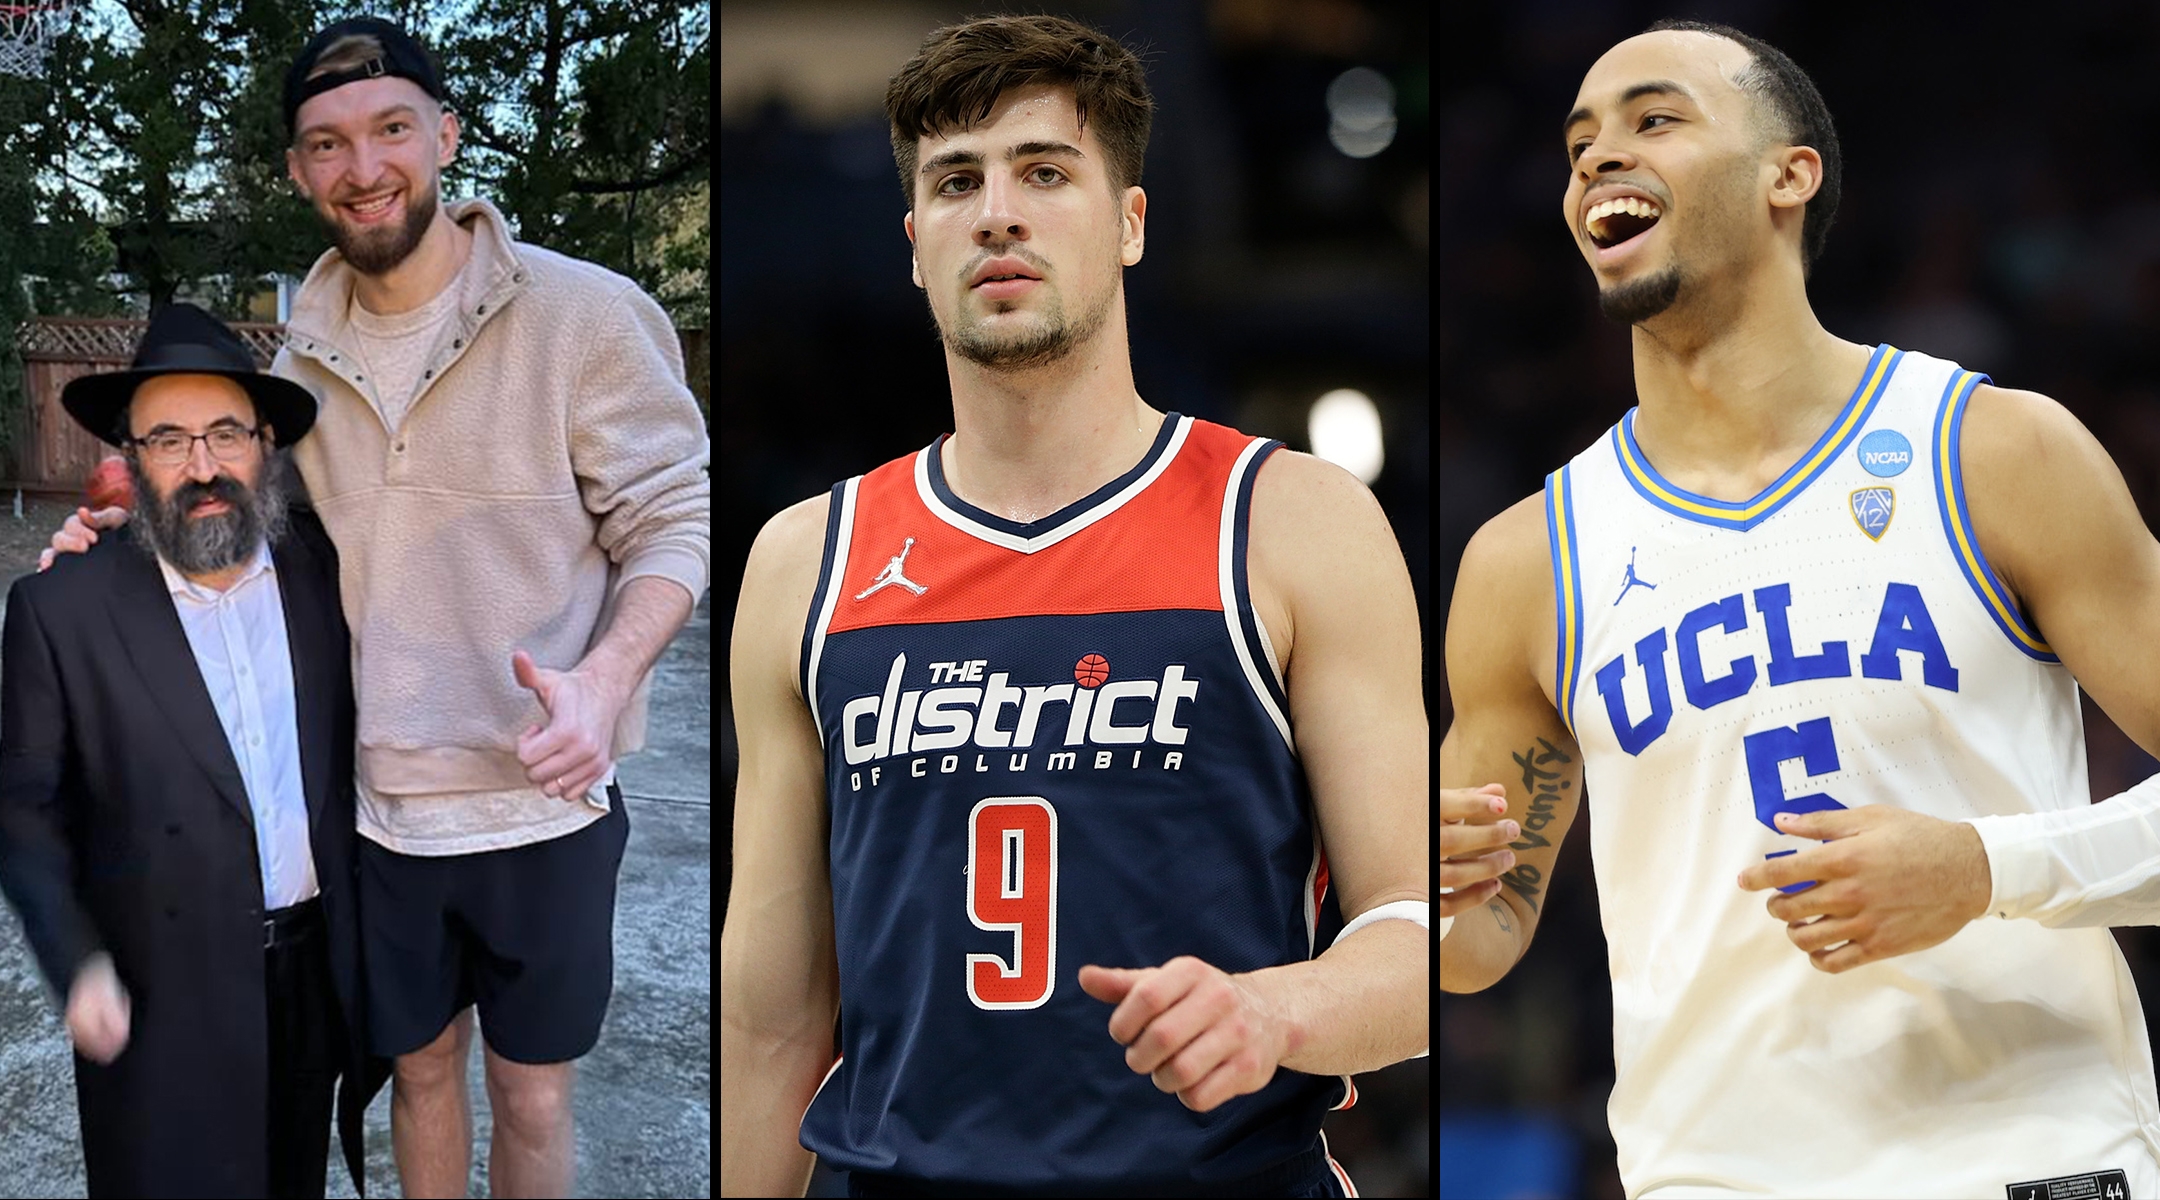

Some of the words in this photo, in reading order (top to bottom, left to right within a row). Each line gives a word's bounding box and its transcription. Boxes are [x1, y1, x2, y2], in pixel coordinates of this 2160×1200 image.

[1865, 451, 1909, 465] NCAA
[1852, 489, 1892, 519] PAC
[1863, 508, 1884, 529] 12
[928, 659, 988, 683] THE
[1595, 582, 1959, 757] UCLA
[842, 652, 1200, 766] district
[850, 766, 881, 792] OF
[1508, 736, 1572, 851] Vanity
[966, 796, 1059, 1011] 9
[1501, 863, 1542, 915] No
[2106, 1182, 2124, 1200] 44
